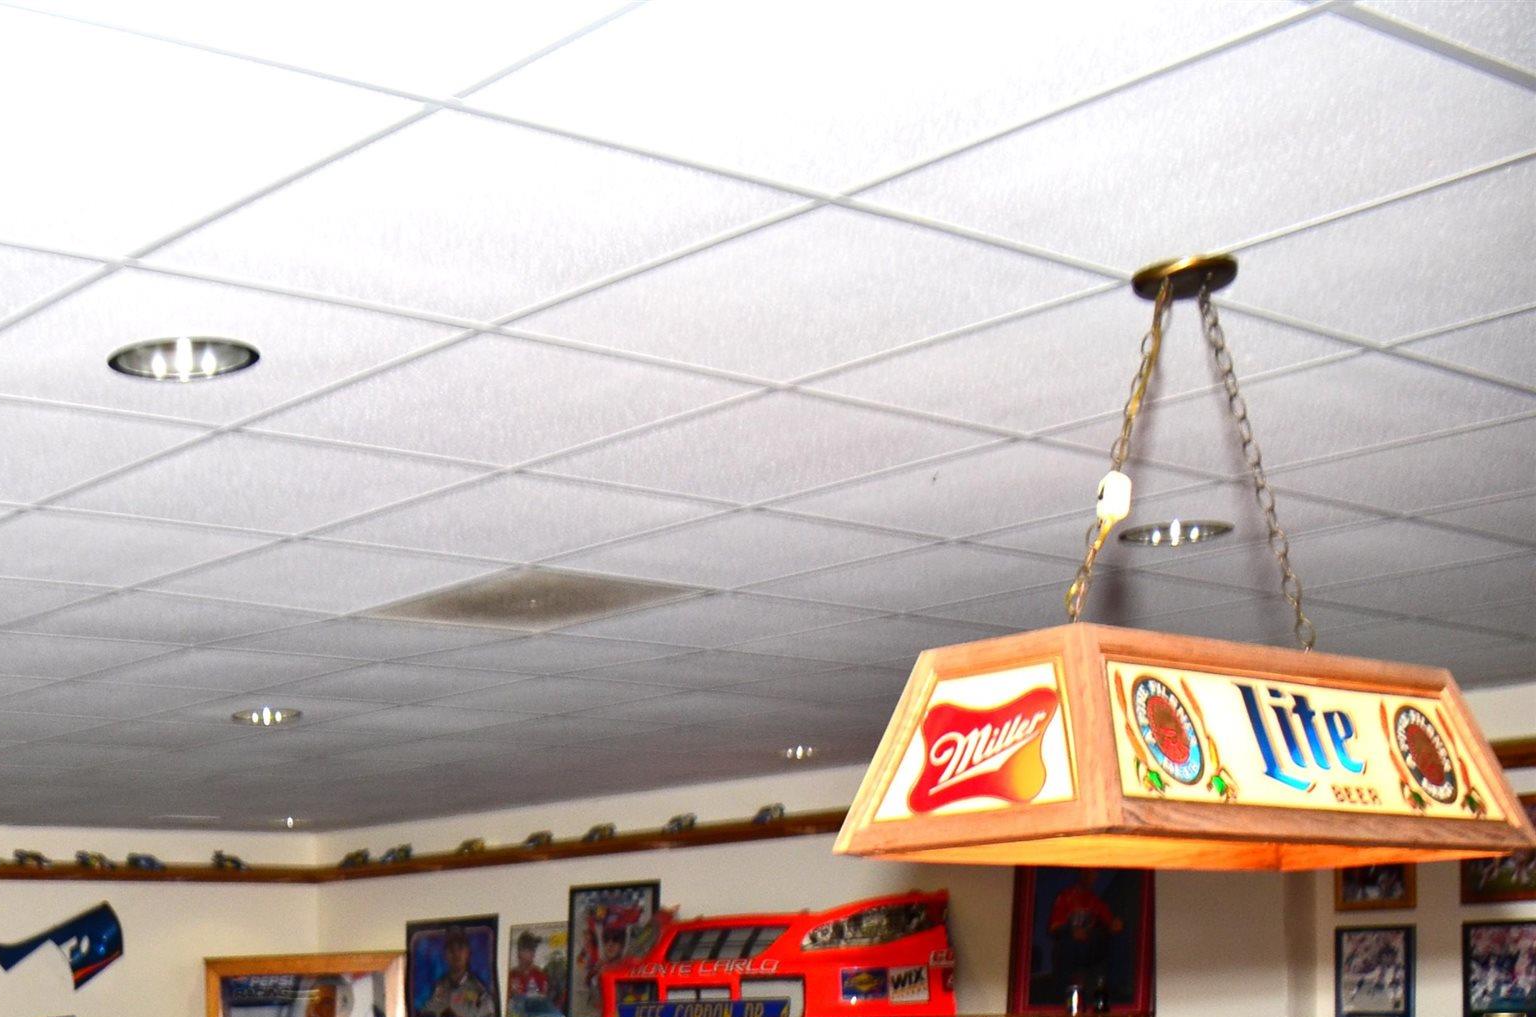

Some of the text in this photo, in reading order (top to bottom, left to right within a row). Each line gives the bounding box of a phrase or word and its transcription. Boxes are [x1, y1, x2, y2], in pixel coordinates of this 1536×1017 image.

[930, 711, 1047, 785] Miller
[1235, 684, 1367, 792] Lite
[1331, 784, 1382, 804] BEER
[698, 958, 780, 974] CARLO
[891, 966, 924, 990] WIX
